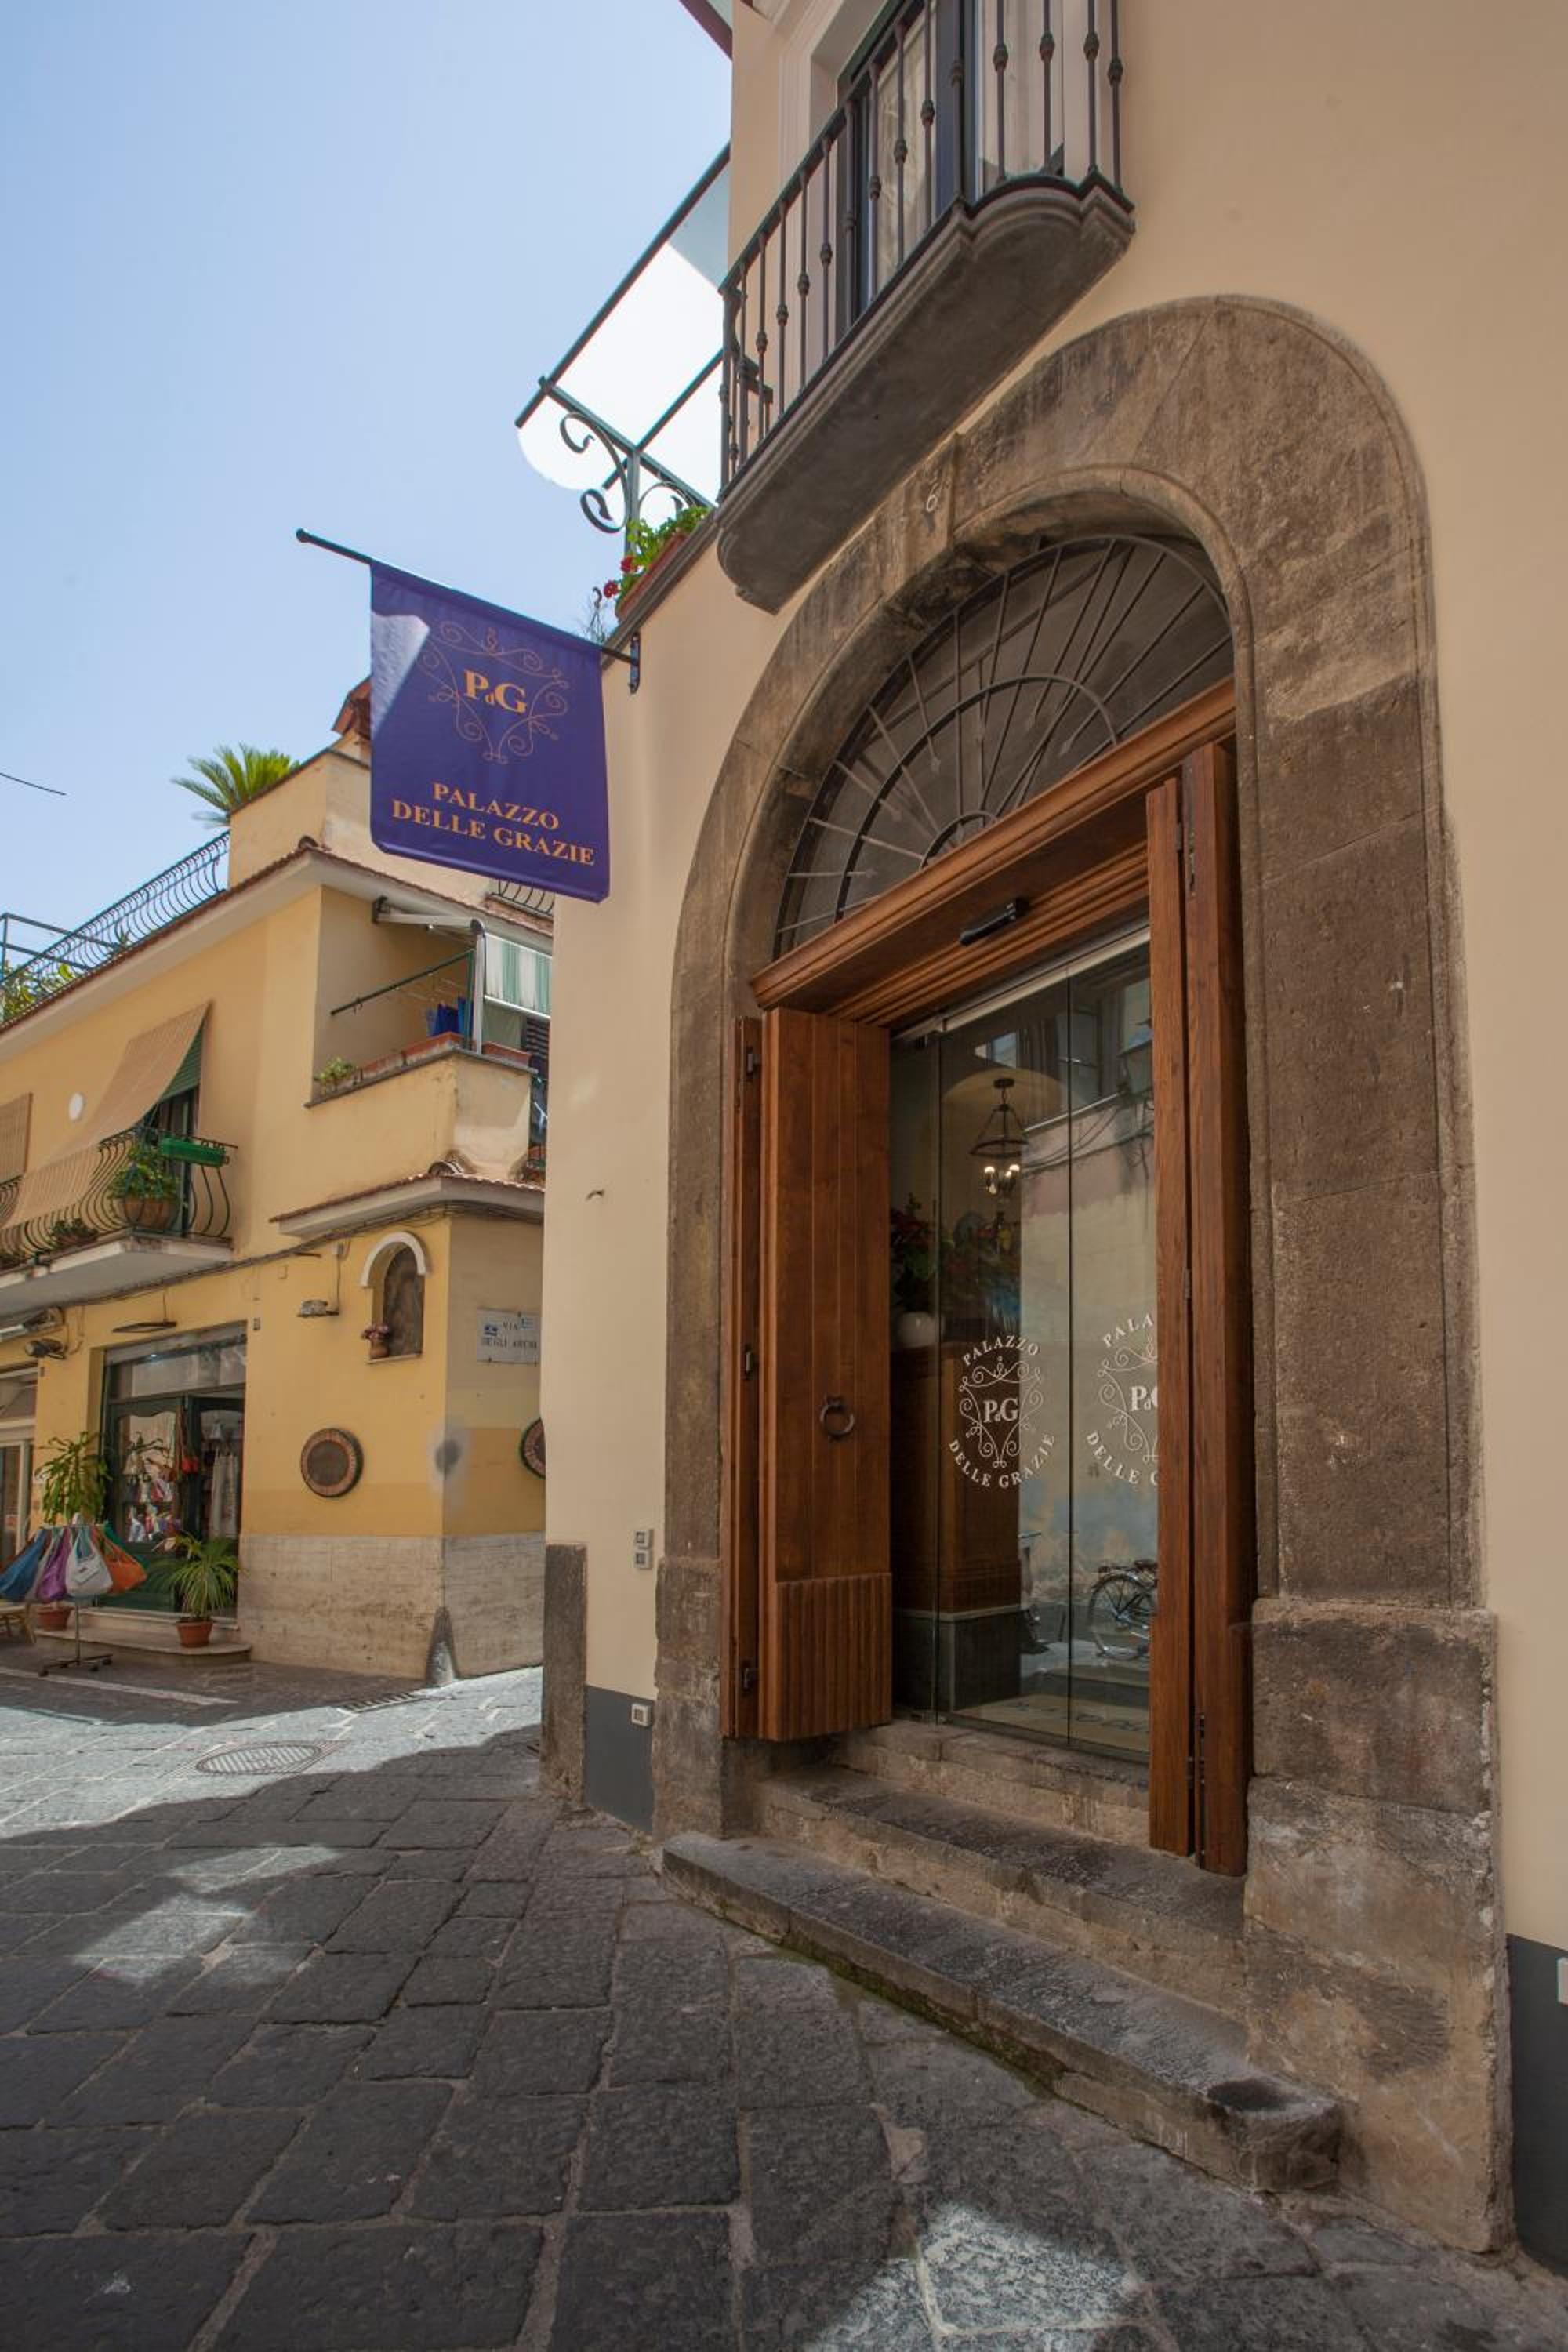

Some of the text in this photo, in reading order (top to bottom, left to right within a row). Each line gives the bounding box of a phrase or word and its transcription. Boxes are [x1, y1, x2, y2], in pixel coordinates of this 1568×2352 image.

[433, 782, 560, 831] PALAZZO
[393, 800, 596, 866] DELLE GRAZIE
[503, 1321, 518, 1330] VIA
[1102, 1313, 1155, 1348] PALA
[962, 1335, 1040, 1366] PALAZZO
[949, 1433, 1054, 1488] DELLE GRAZIE
[1087, 1432, 1140, 1485] DELLE
